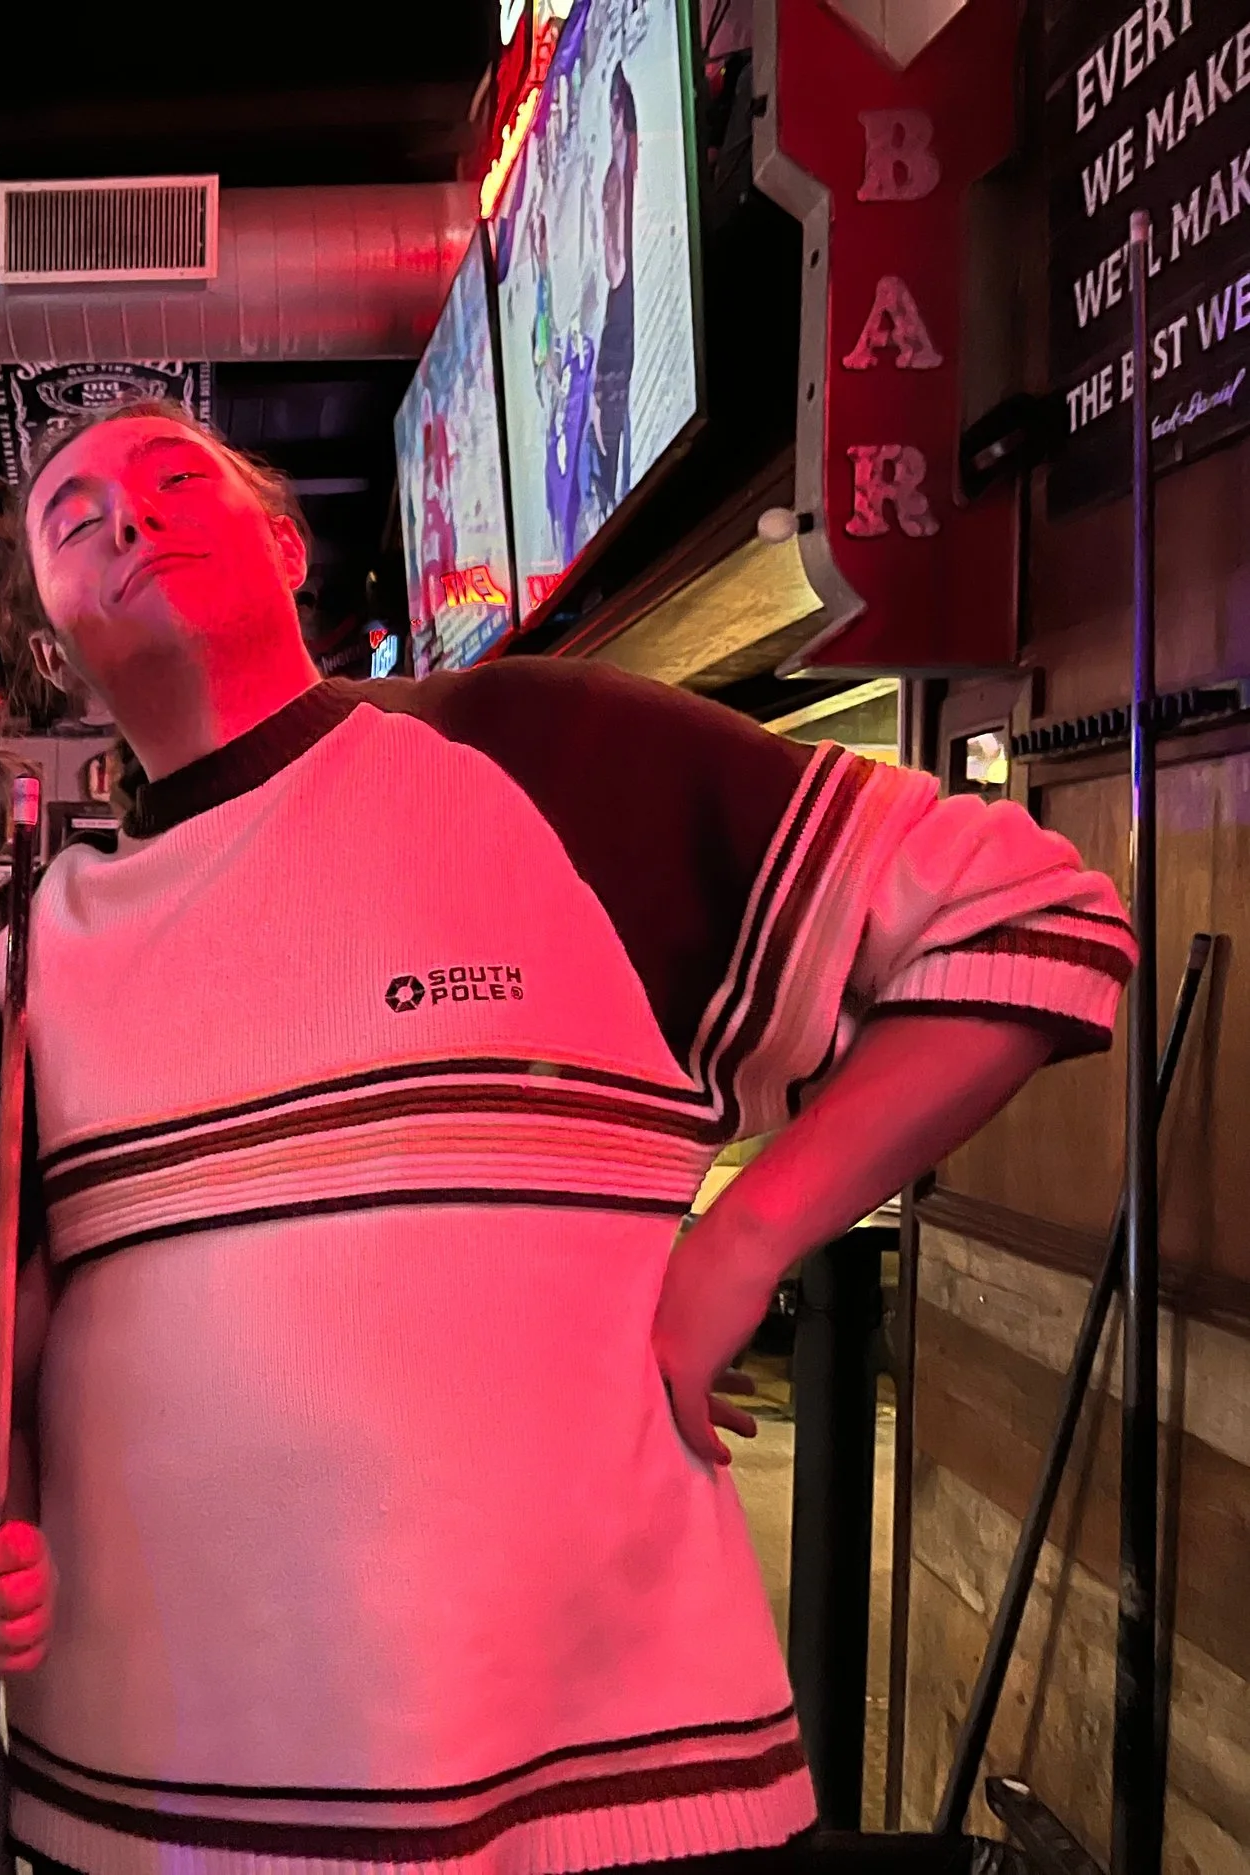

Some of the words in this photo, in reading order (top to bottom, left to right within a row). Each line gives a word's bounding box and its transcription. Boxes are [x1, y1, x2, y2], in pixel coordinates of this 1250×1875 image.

[1081, 127, 1134, 217] WE
[843, 107, 943, 537] BAR
[1074, 223, 1162, 329] WE'L
[1066, 365, 1113, 433] THE
[1120, 316, 1188, 403] BST
[428, 965, 522, 986] SOUTH
